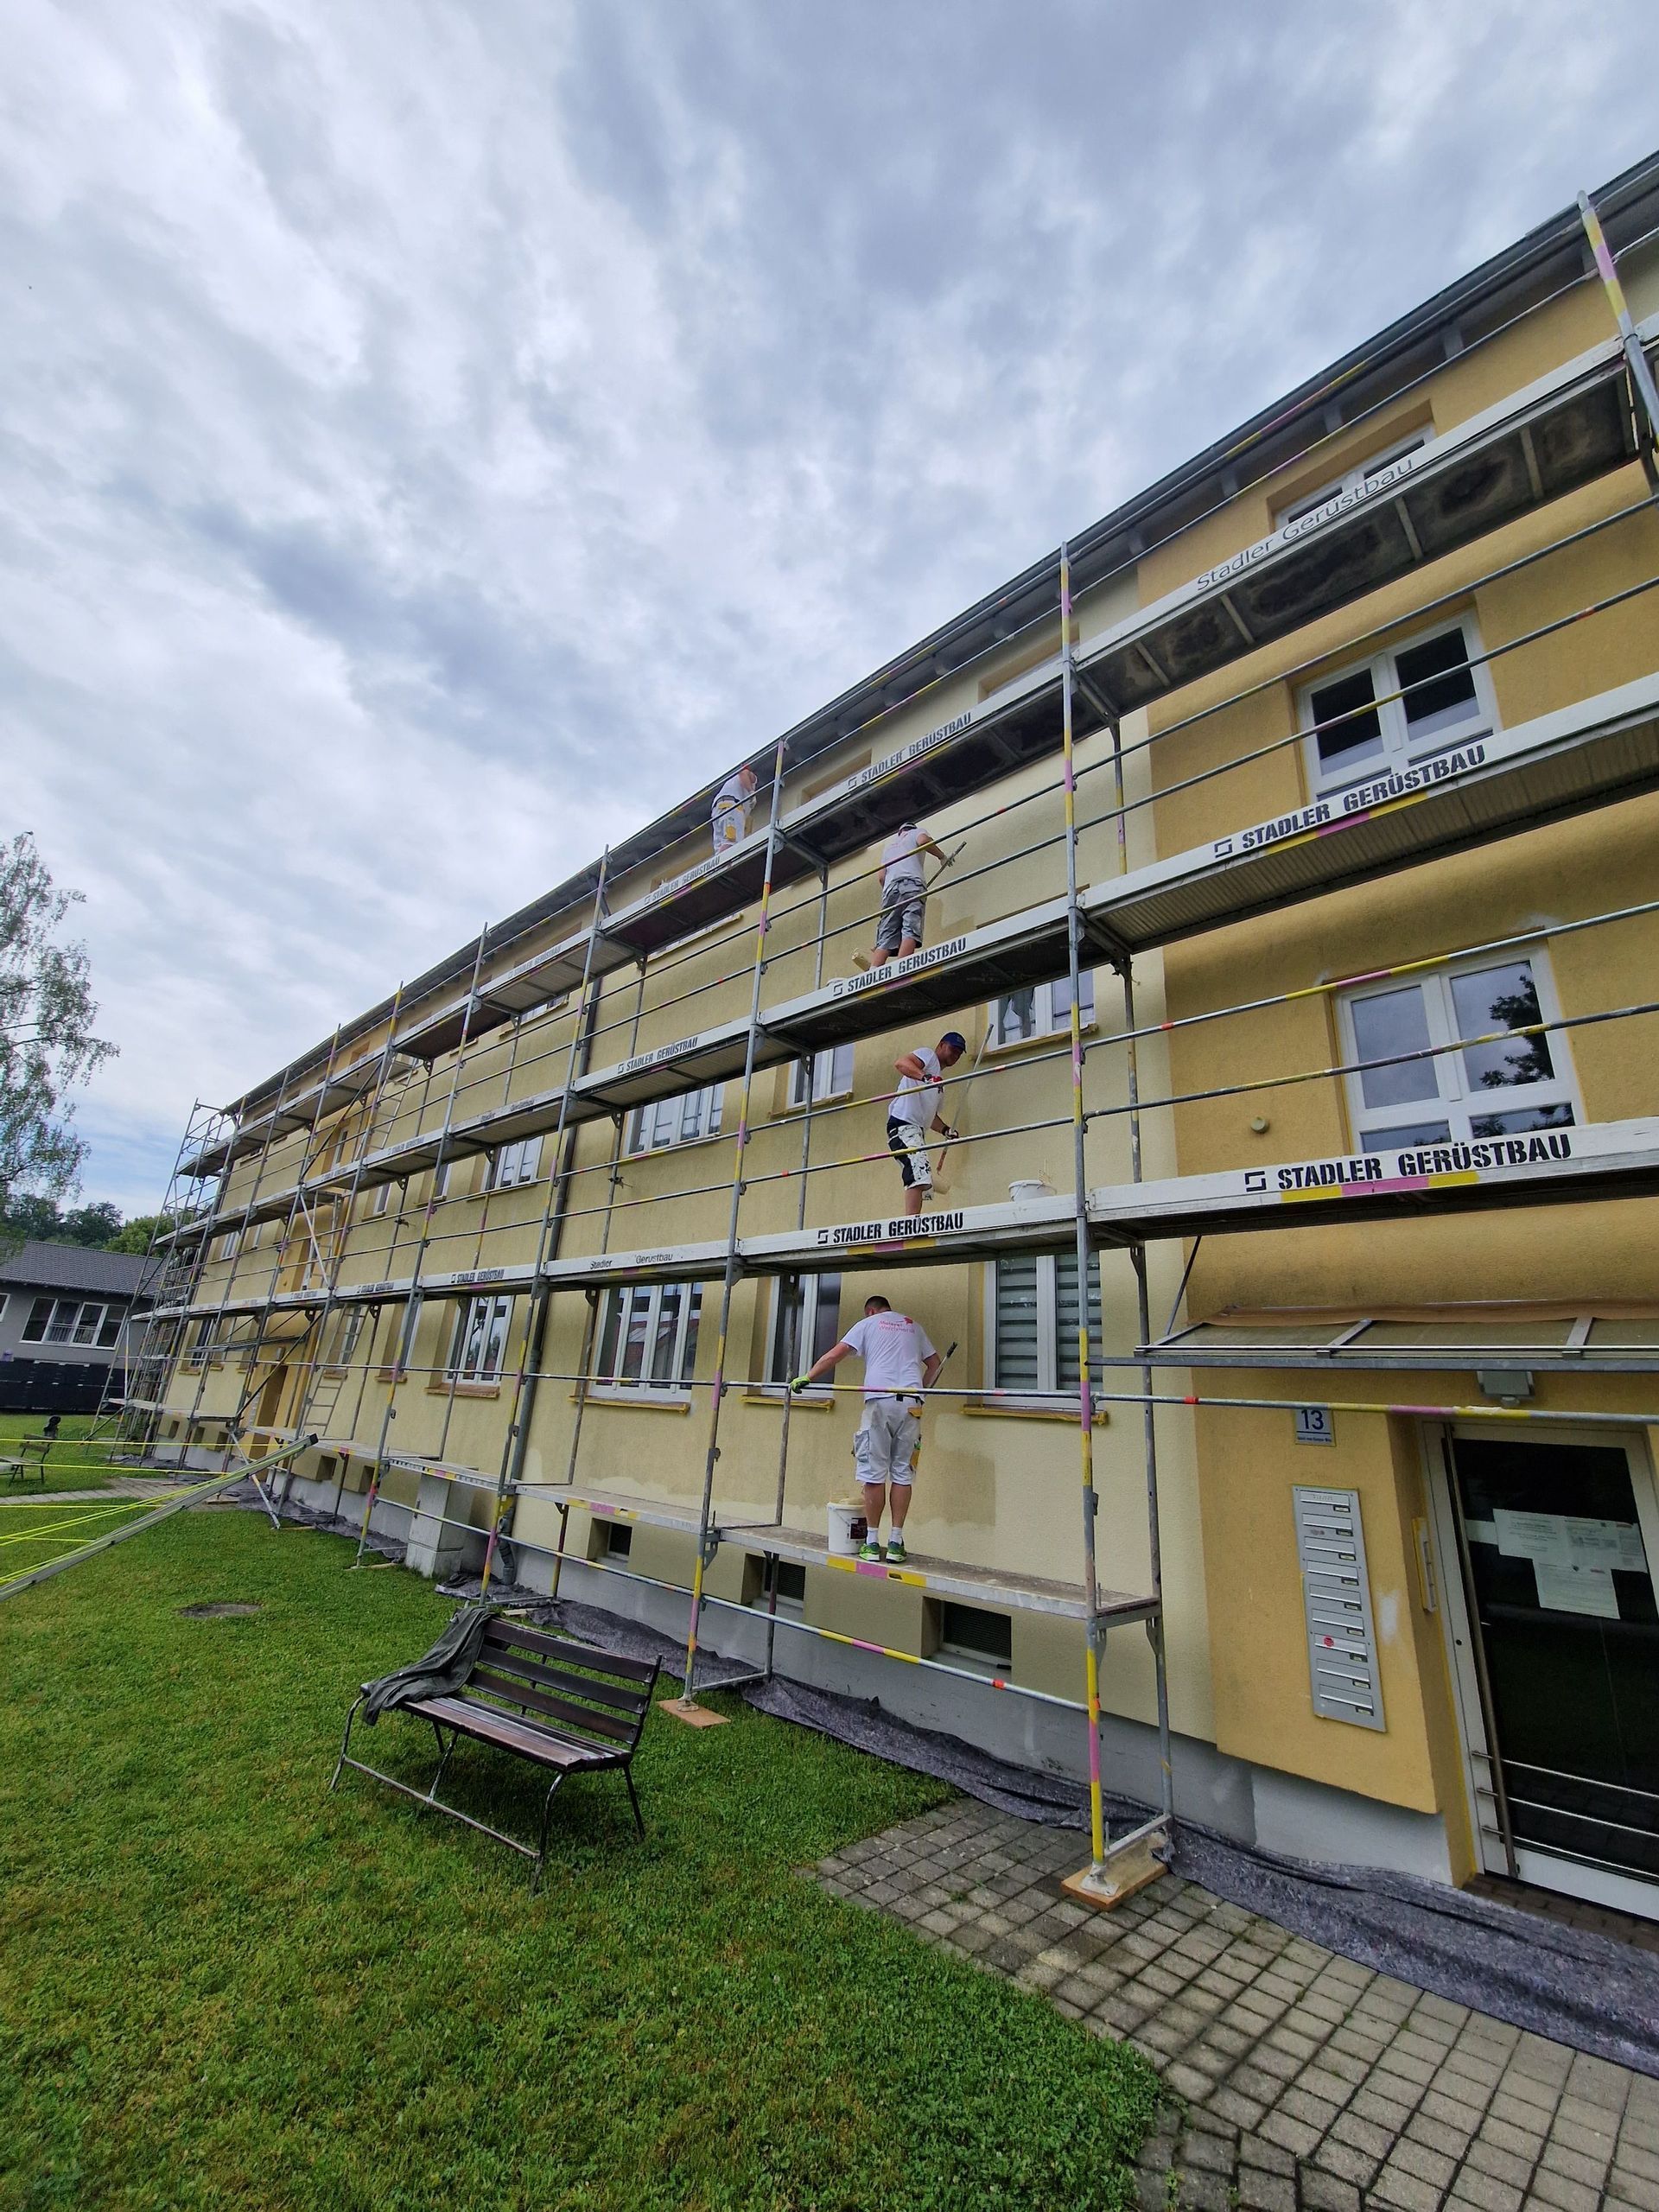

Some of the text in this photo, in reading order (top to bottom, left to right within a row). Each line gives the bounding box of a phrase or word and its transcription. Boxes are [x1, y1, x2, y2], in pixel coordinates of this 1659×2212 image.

[1198, 459, 1413, 591] Stadler Gerüstbau
[861, 747, 906, 783] STADLER
[1243, 745, 1485, 849] STADLER GERÜSTBAU
[848, 965, 893, 993] STADLER
[626, 1052, 654, 1071] STADLER
[1277, 1134, 1572, 1190] STADLER GERÜSTBAU
[833, 1212, 963, 1244] STADLER GERÜSTBAU
[1301, 1408, 1324, 1430] 13
